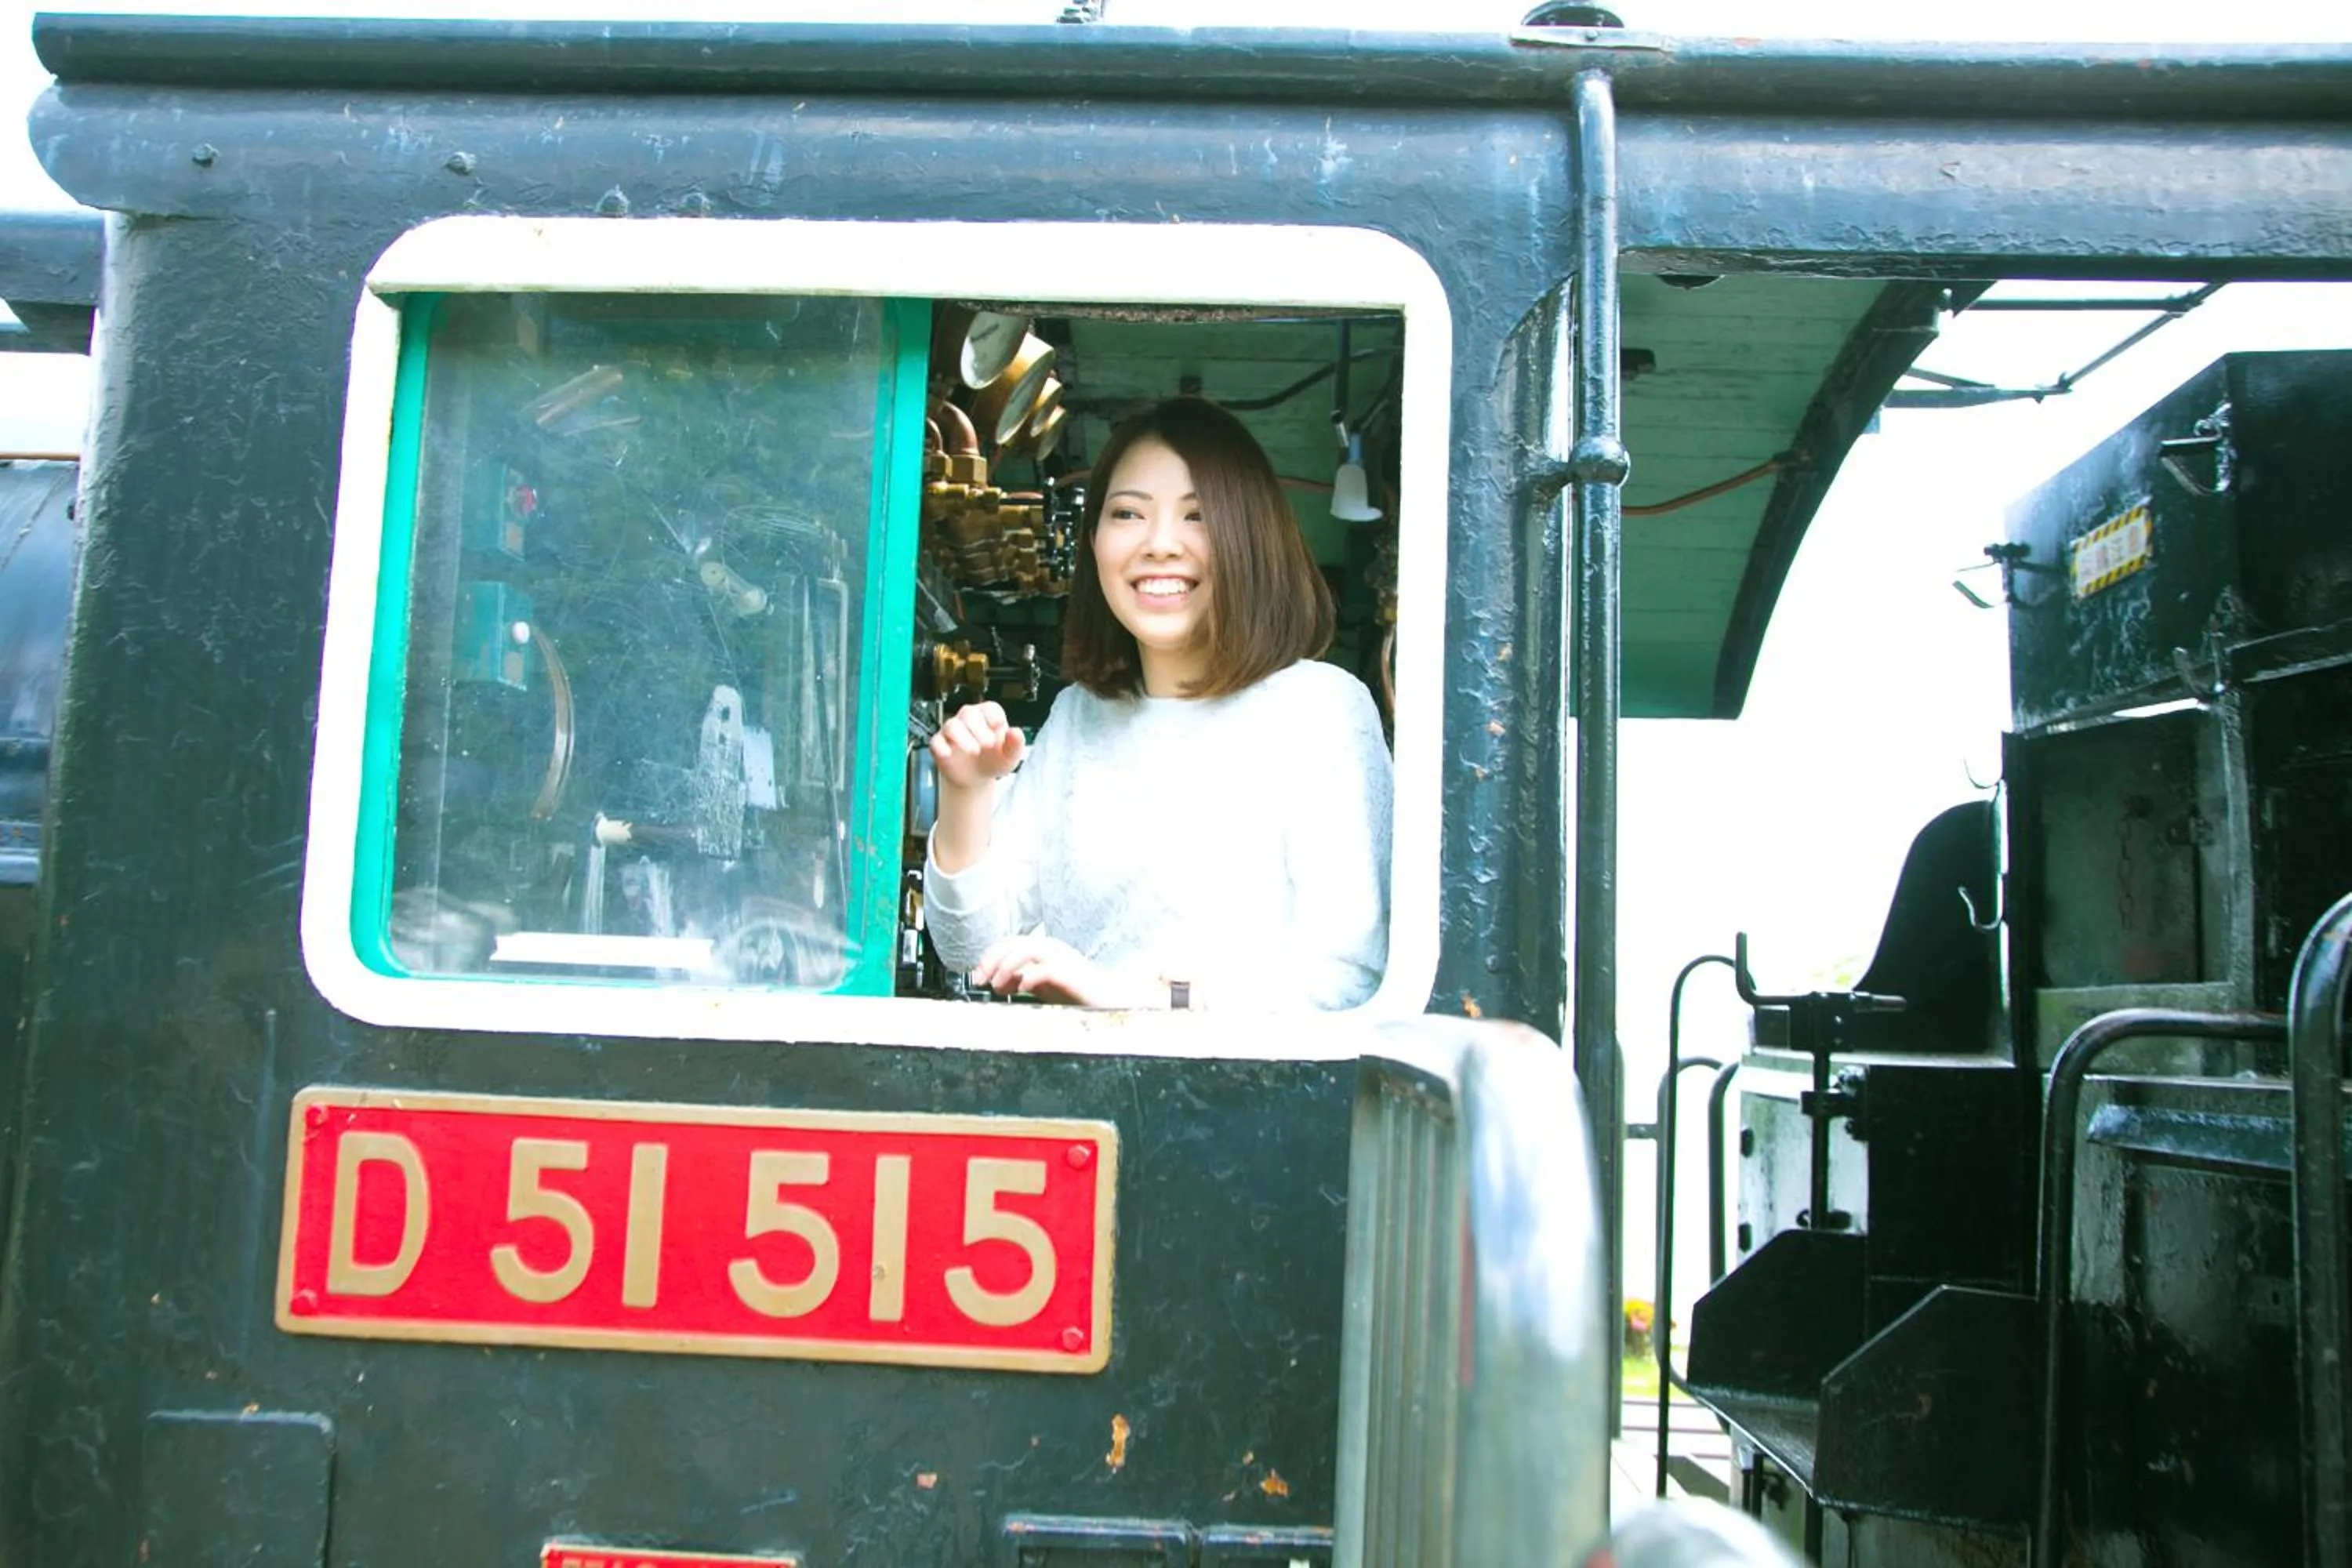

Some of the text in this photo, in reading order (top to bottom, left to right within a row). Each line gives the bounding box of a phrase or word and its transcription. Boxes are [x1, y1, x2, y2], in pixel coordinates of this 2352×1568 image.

[327, 1131, 1057, 1327] D 51 515
